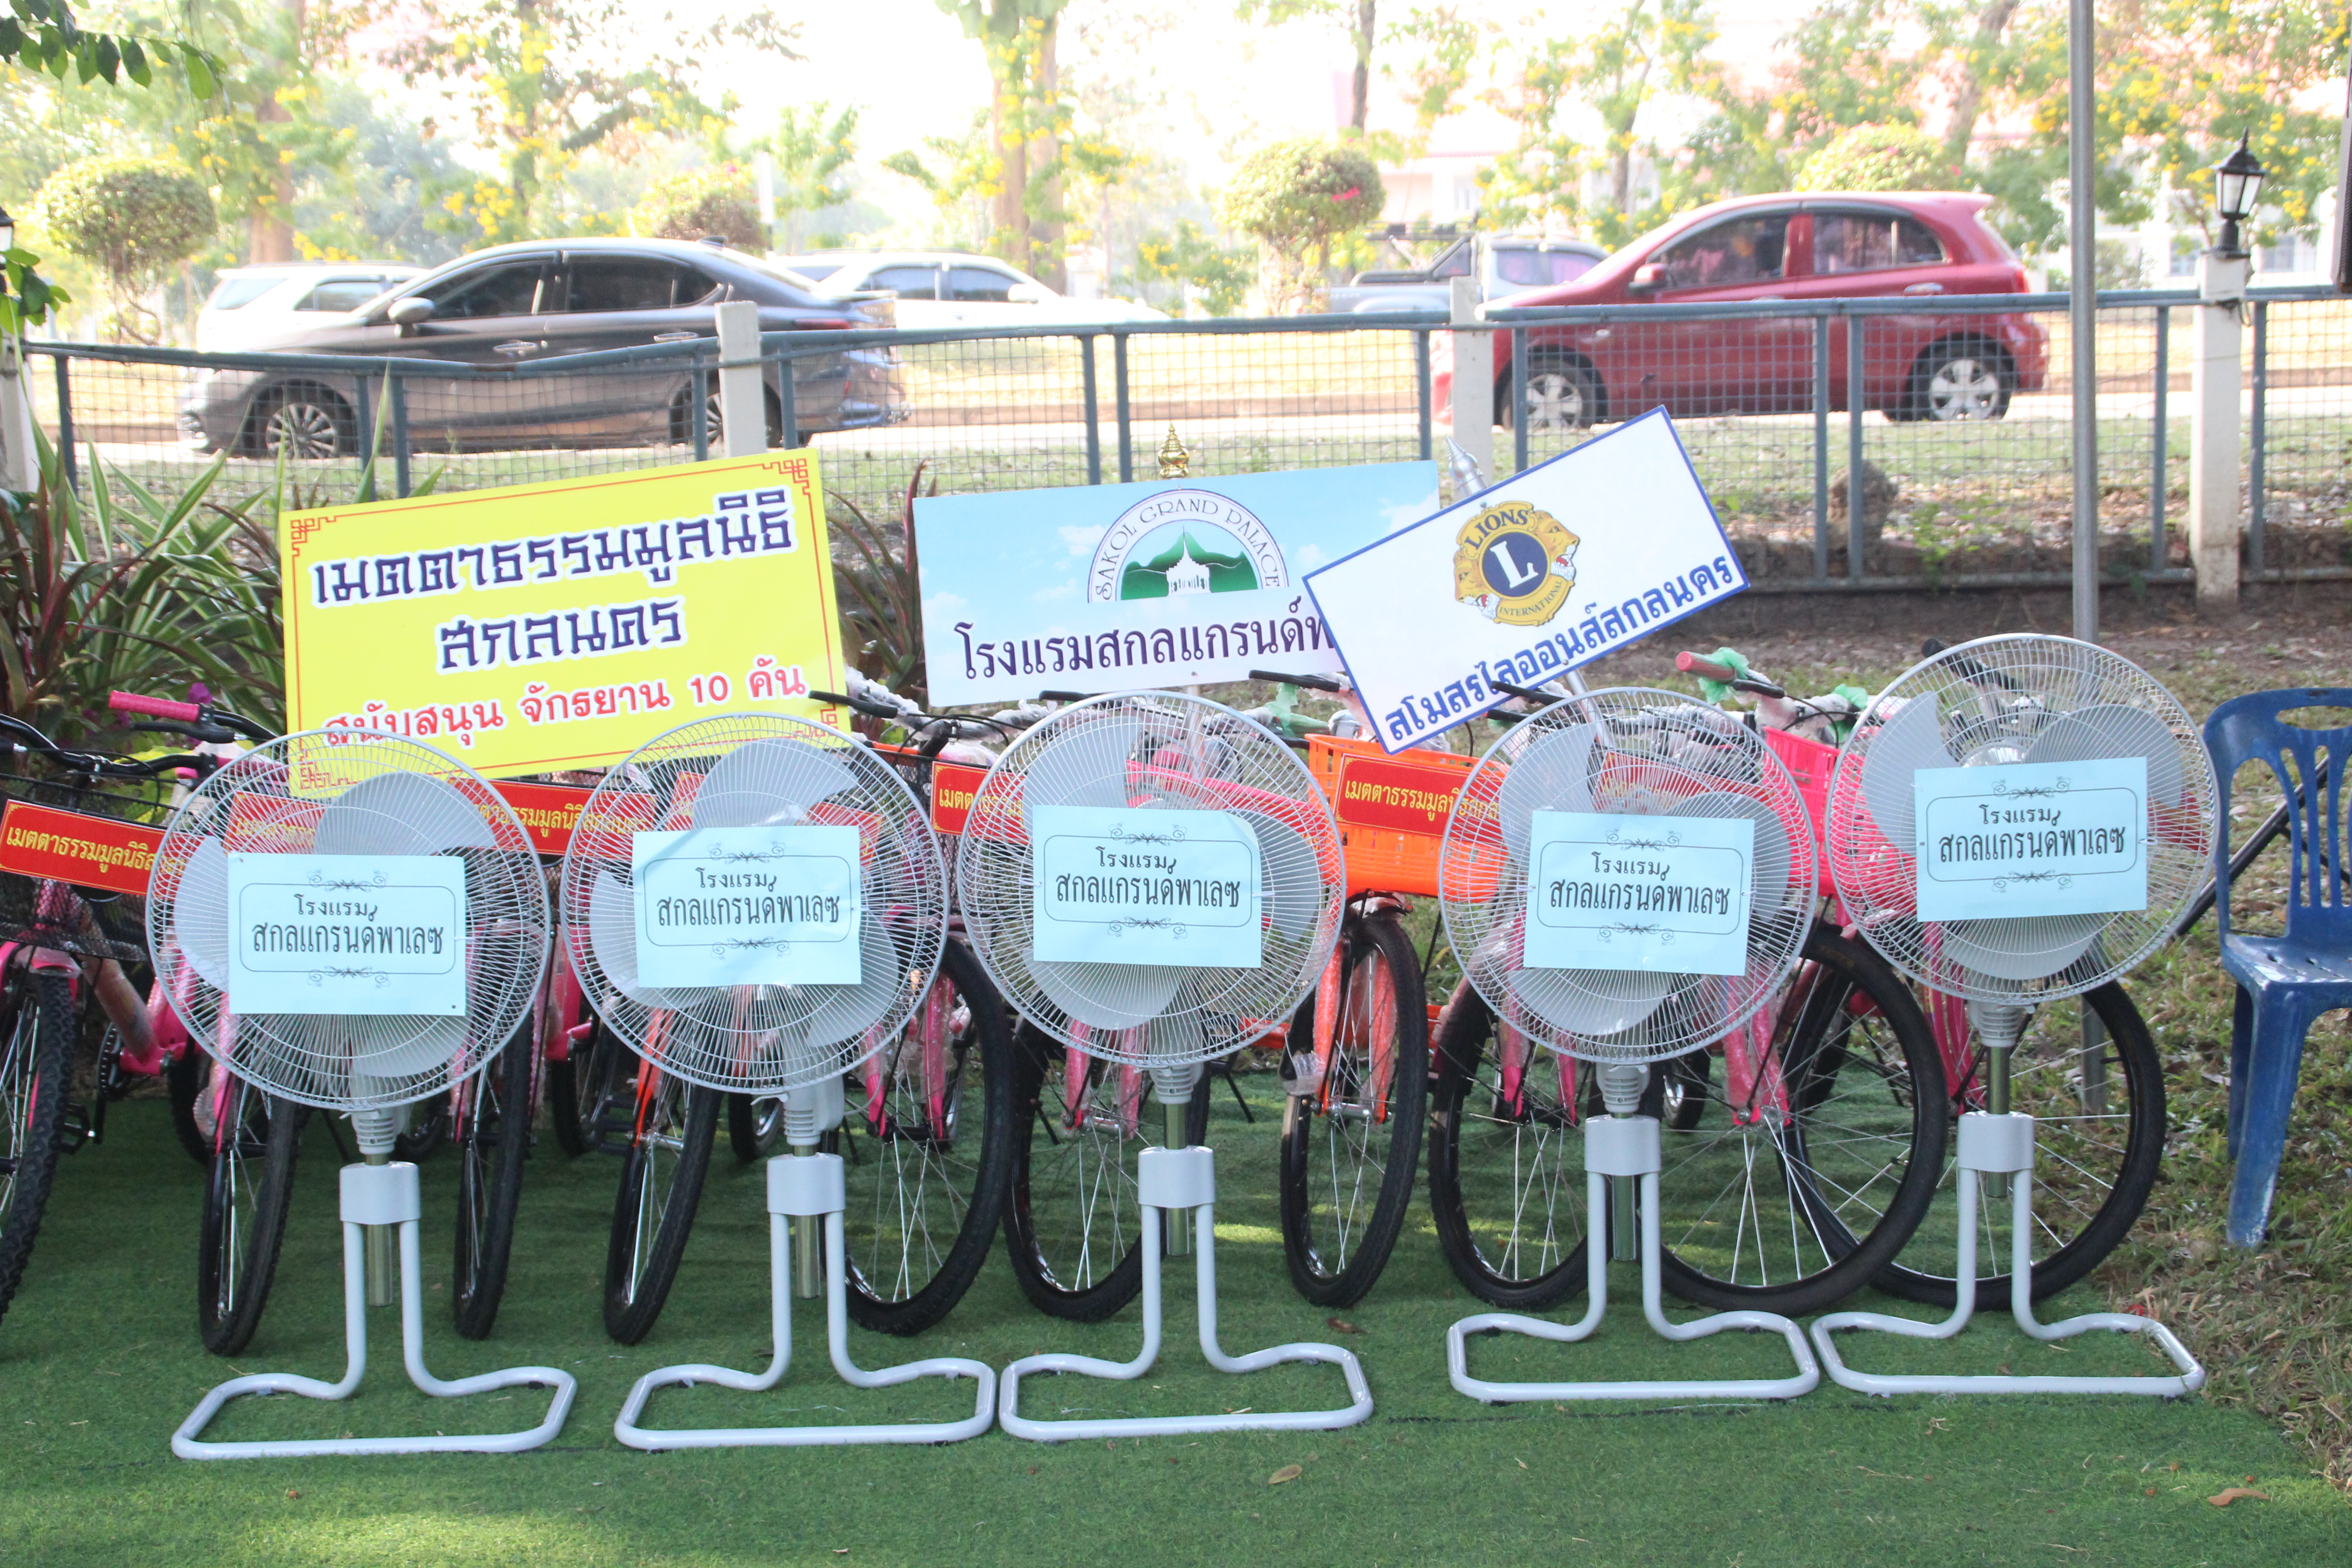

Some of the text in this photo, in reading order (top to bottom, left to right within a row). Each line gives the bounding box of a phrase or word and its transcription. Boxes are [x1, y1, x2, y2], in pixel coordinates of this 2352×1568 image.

[314, 489, 792, 603] เมตตาธรรมมูลนิธิ
[1095, 499, 1280, 600] SAKOL GRAND PALACE
[1464, 509, 1529, 550] LIONS
[1490, 540, 1539, 588] L
[1499, 579, 1563, 616] INTERNATIONAL
[441, 600, 683, 669] สกลนคร
[1385, 555, 1734, 742] สโมสรไลออนส์สกลนคร
[520, 684, 671, 722] จักรยาน
[690, 675, 729, 703] 10
[750, 657, 806, 698] คัน
